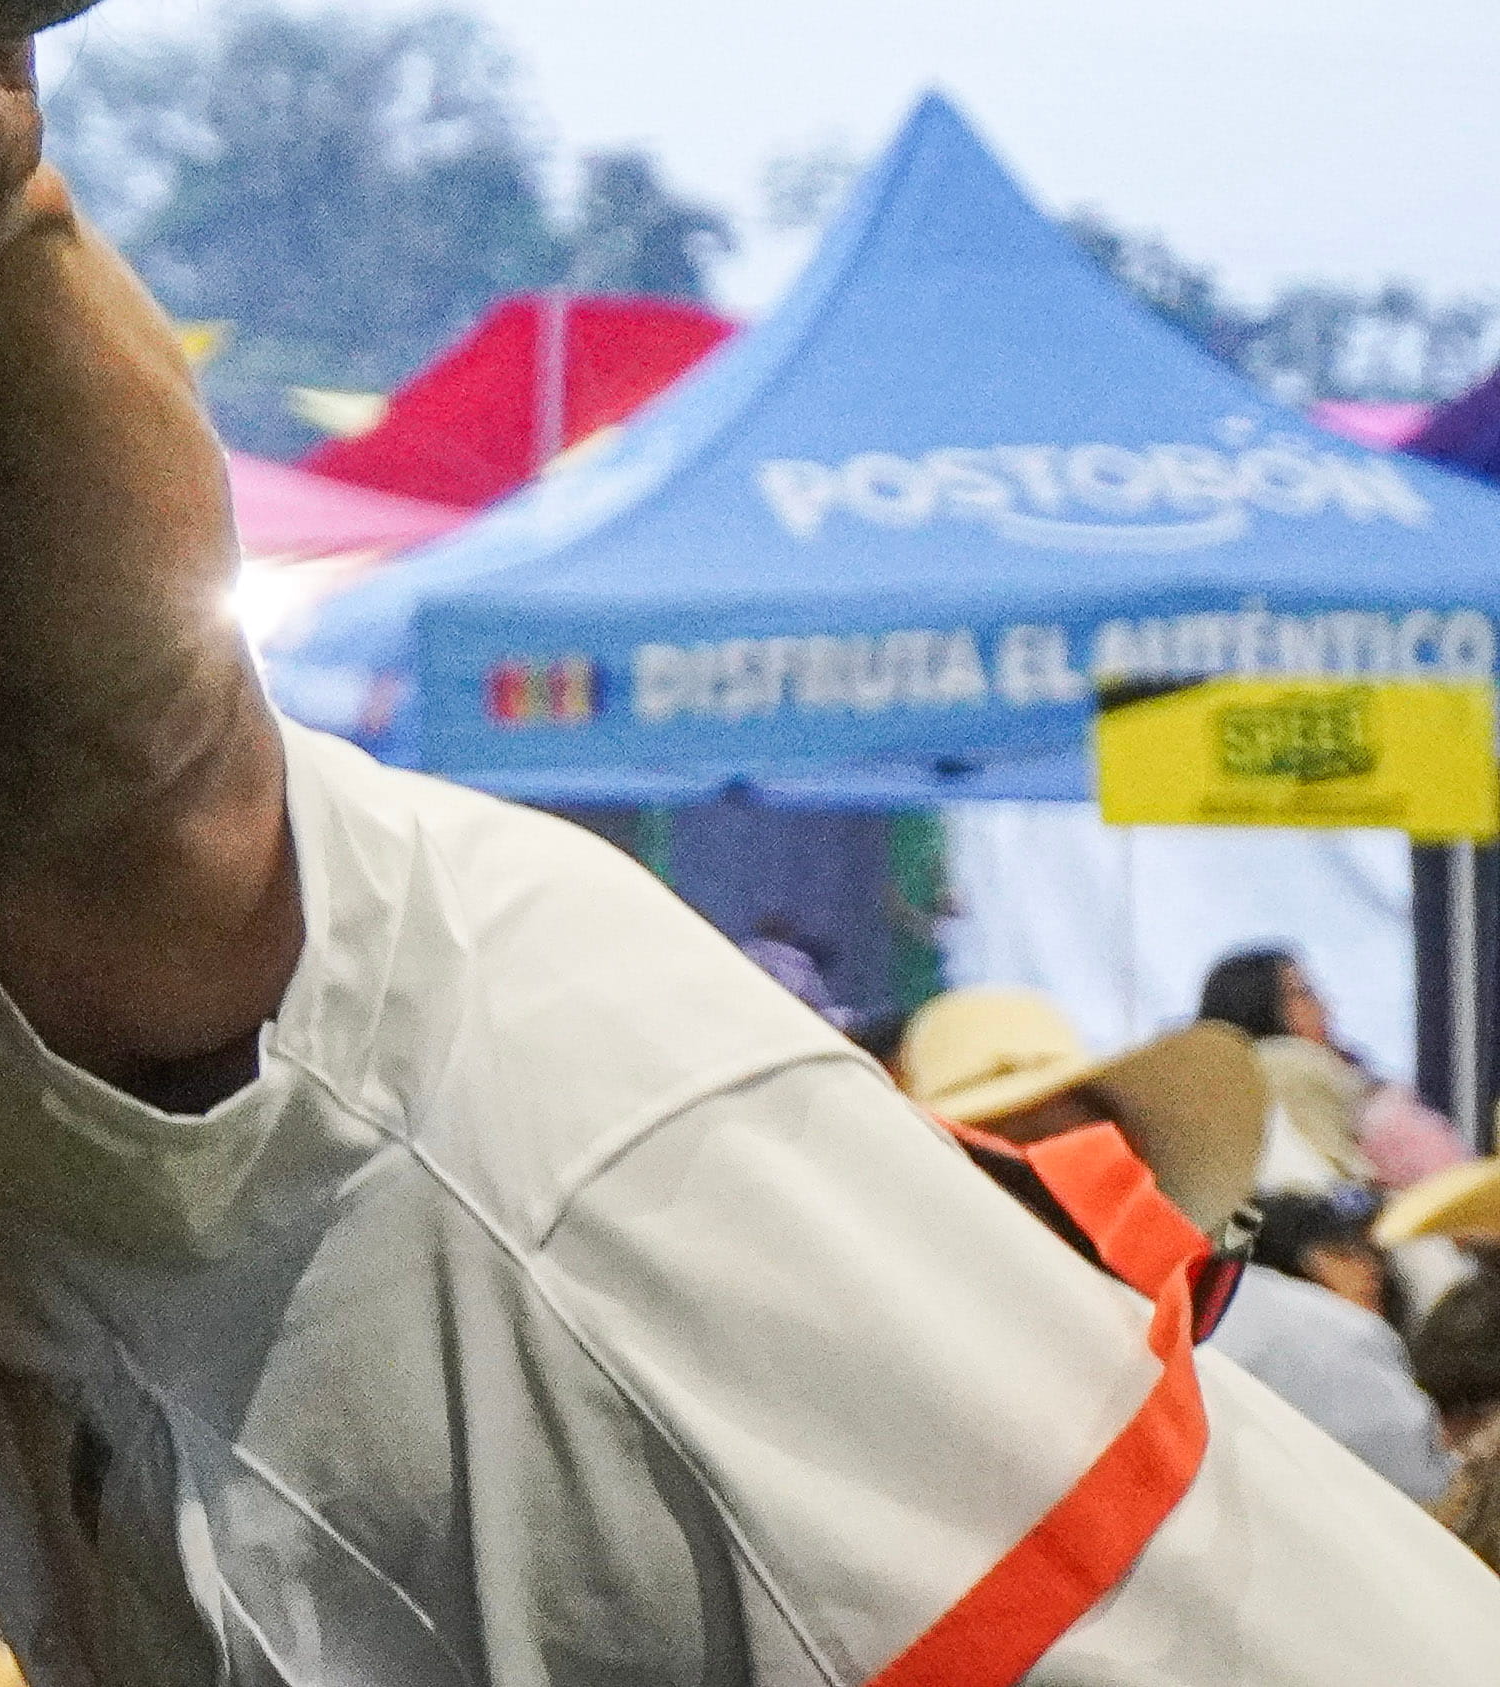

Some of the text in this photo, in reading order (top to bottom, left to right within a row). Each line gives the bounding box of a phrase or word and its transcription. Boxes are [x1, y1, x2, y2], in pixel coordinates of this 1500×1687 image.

[632, 594, 1497, 722] DISFRUTA EL AUTÉNTICO
